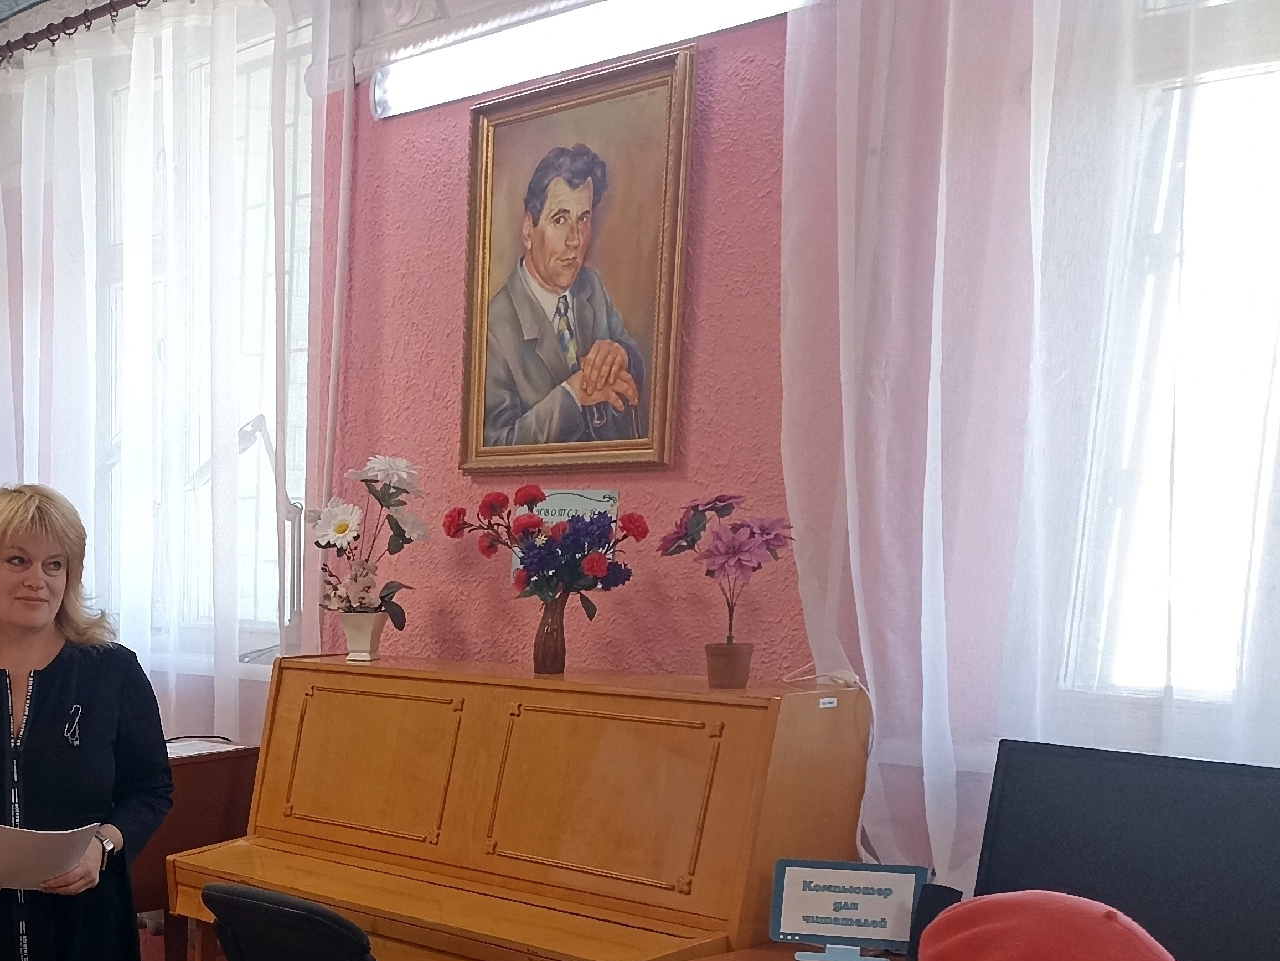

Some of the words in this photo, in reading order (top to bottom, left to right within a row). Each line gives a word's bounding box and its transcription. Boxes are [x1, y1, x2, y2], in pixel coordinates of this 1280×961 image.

[801, 880, 894, 898] Компьютер
[832, 901, 859, 912] для
[801, 915, 888, 929] читателей
